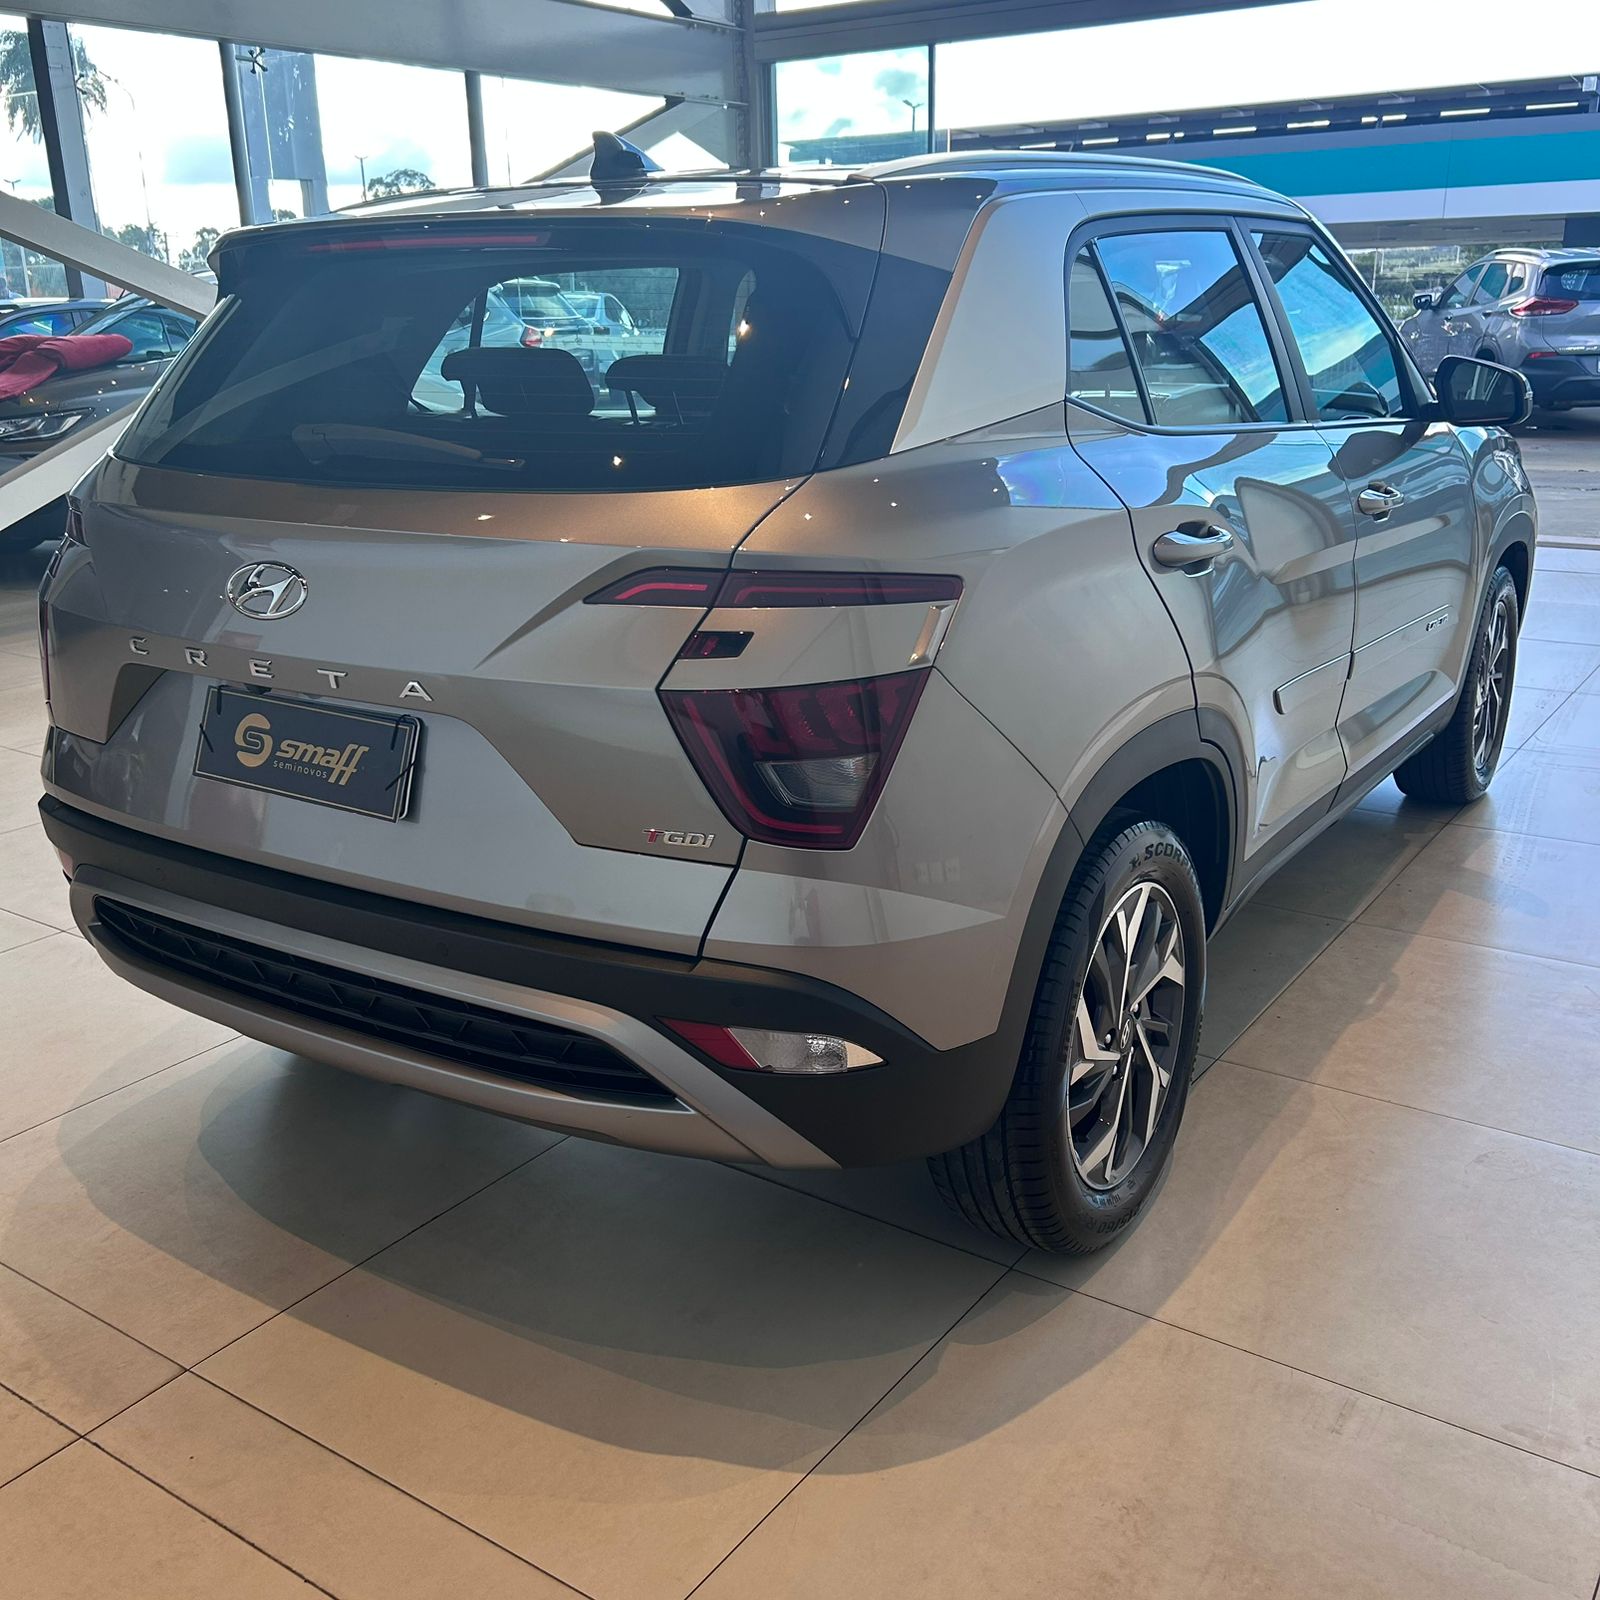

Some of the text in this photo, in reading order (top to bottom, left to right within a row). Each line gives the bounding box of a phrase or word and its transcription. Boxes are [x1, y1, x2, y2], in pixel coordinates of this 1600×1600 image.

[129, 635, 434, 702] CRETA
[273, 759, 328, 779] seminovos
[275, 739, 370, 786] smaff
